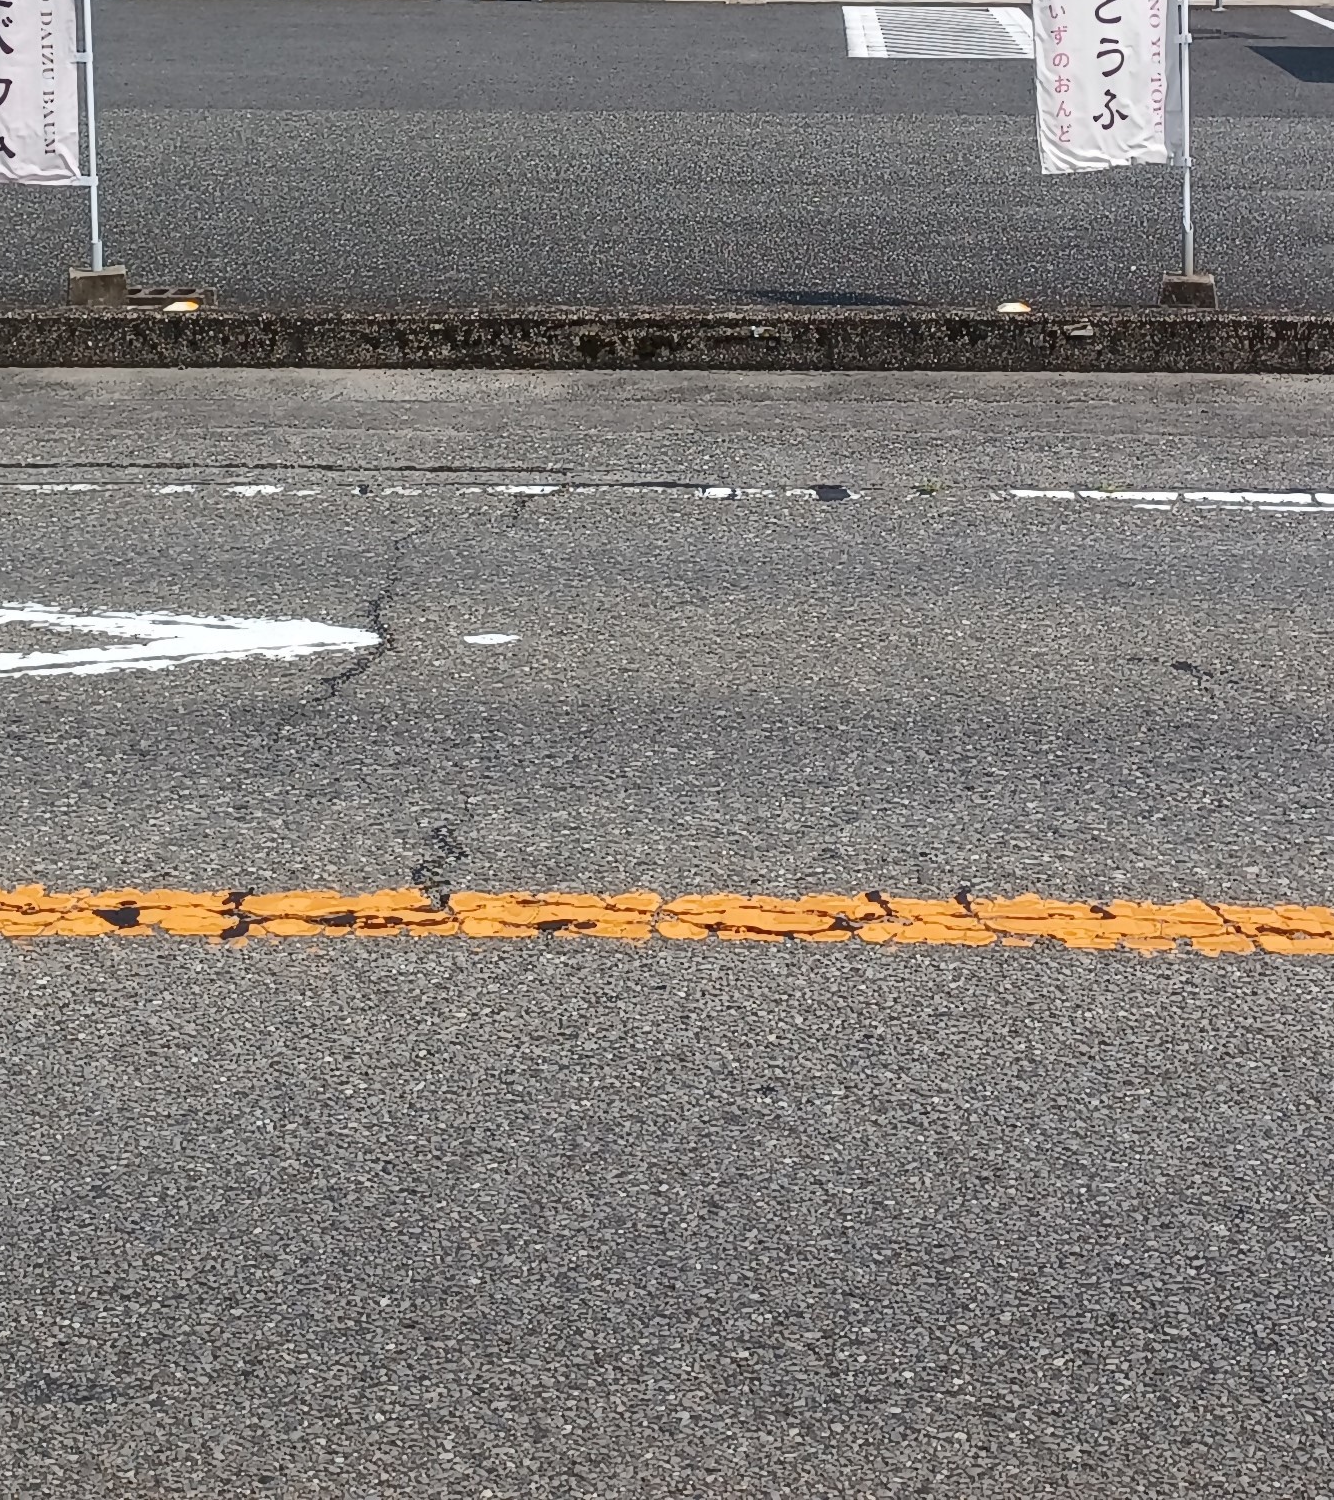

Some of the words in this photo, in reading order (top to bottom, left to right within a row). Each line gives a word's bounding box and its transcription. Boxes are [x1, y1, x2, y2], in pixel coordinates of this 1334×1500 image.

[40, 11, 55, 80] DAIZU
[1150, 36, 1161, 65] YU
[42, 91, 56, 155] BAUM
[1150, 72, 1163, 134] TOFU
